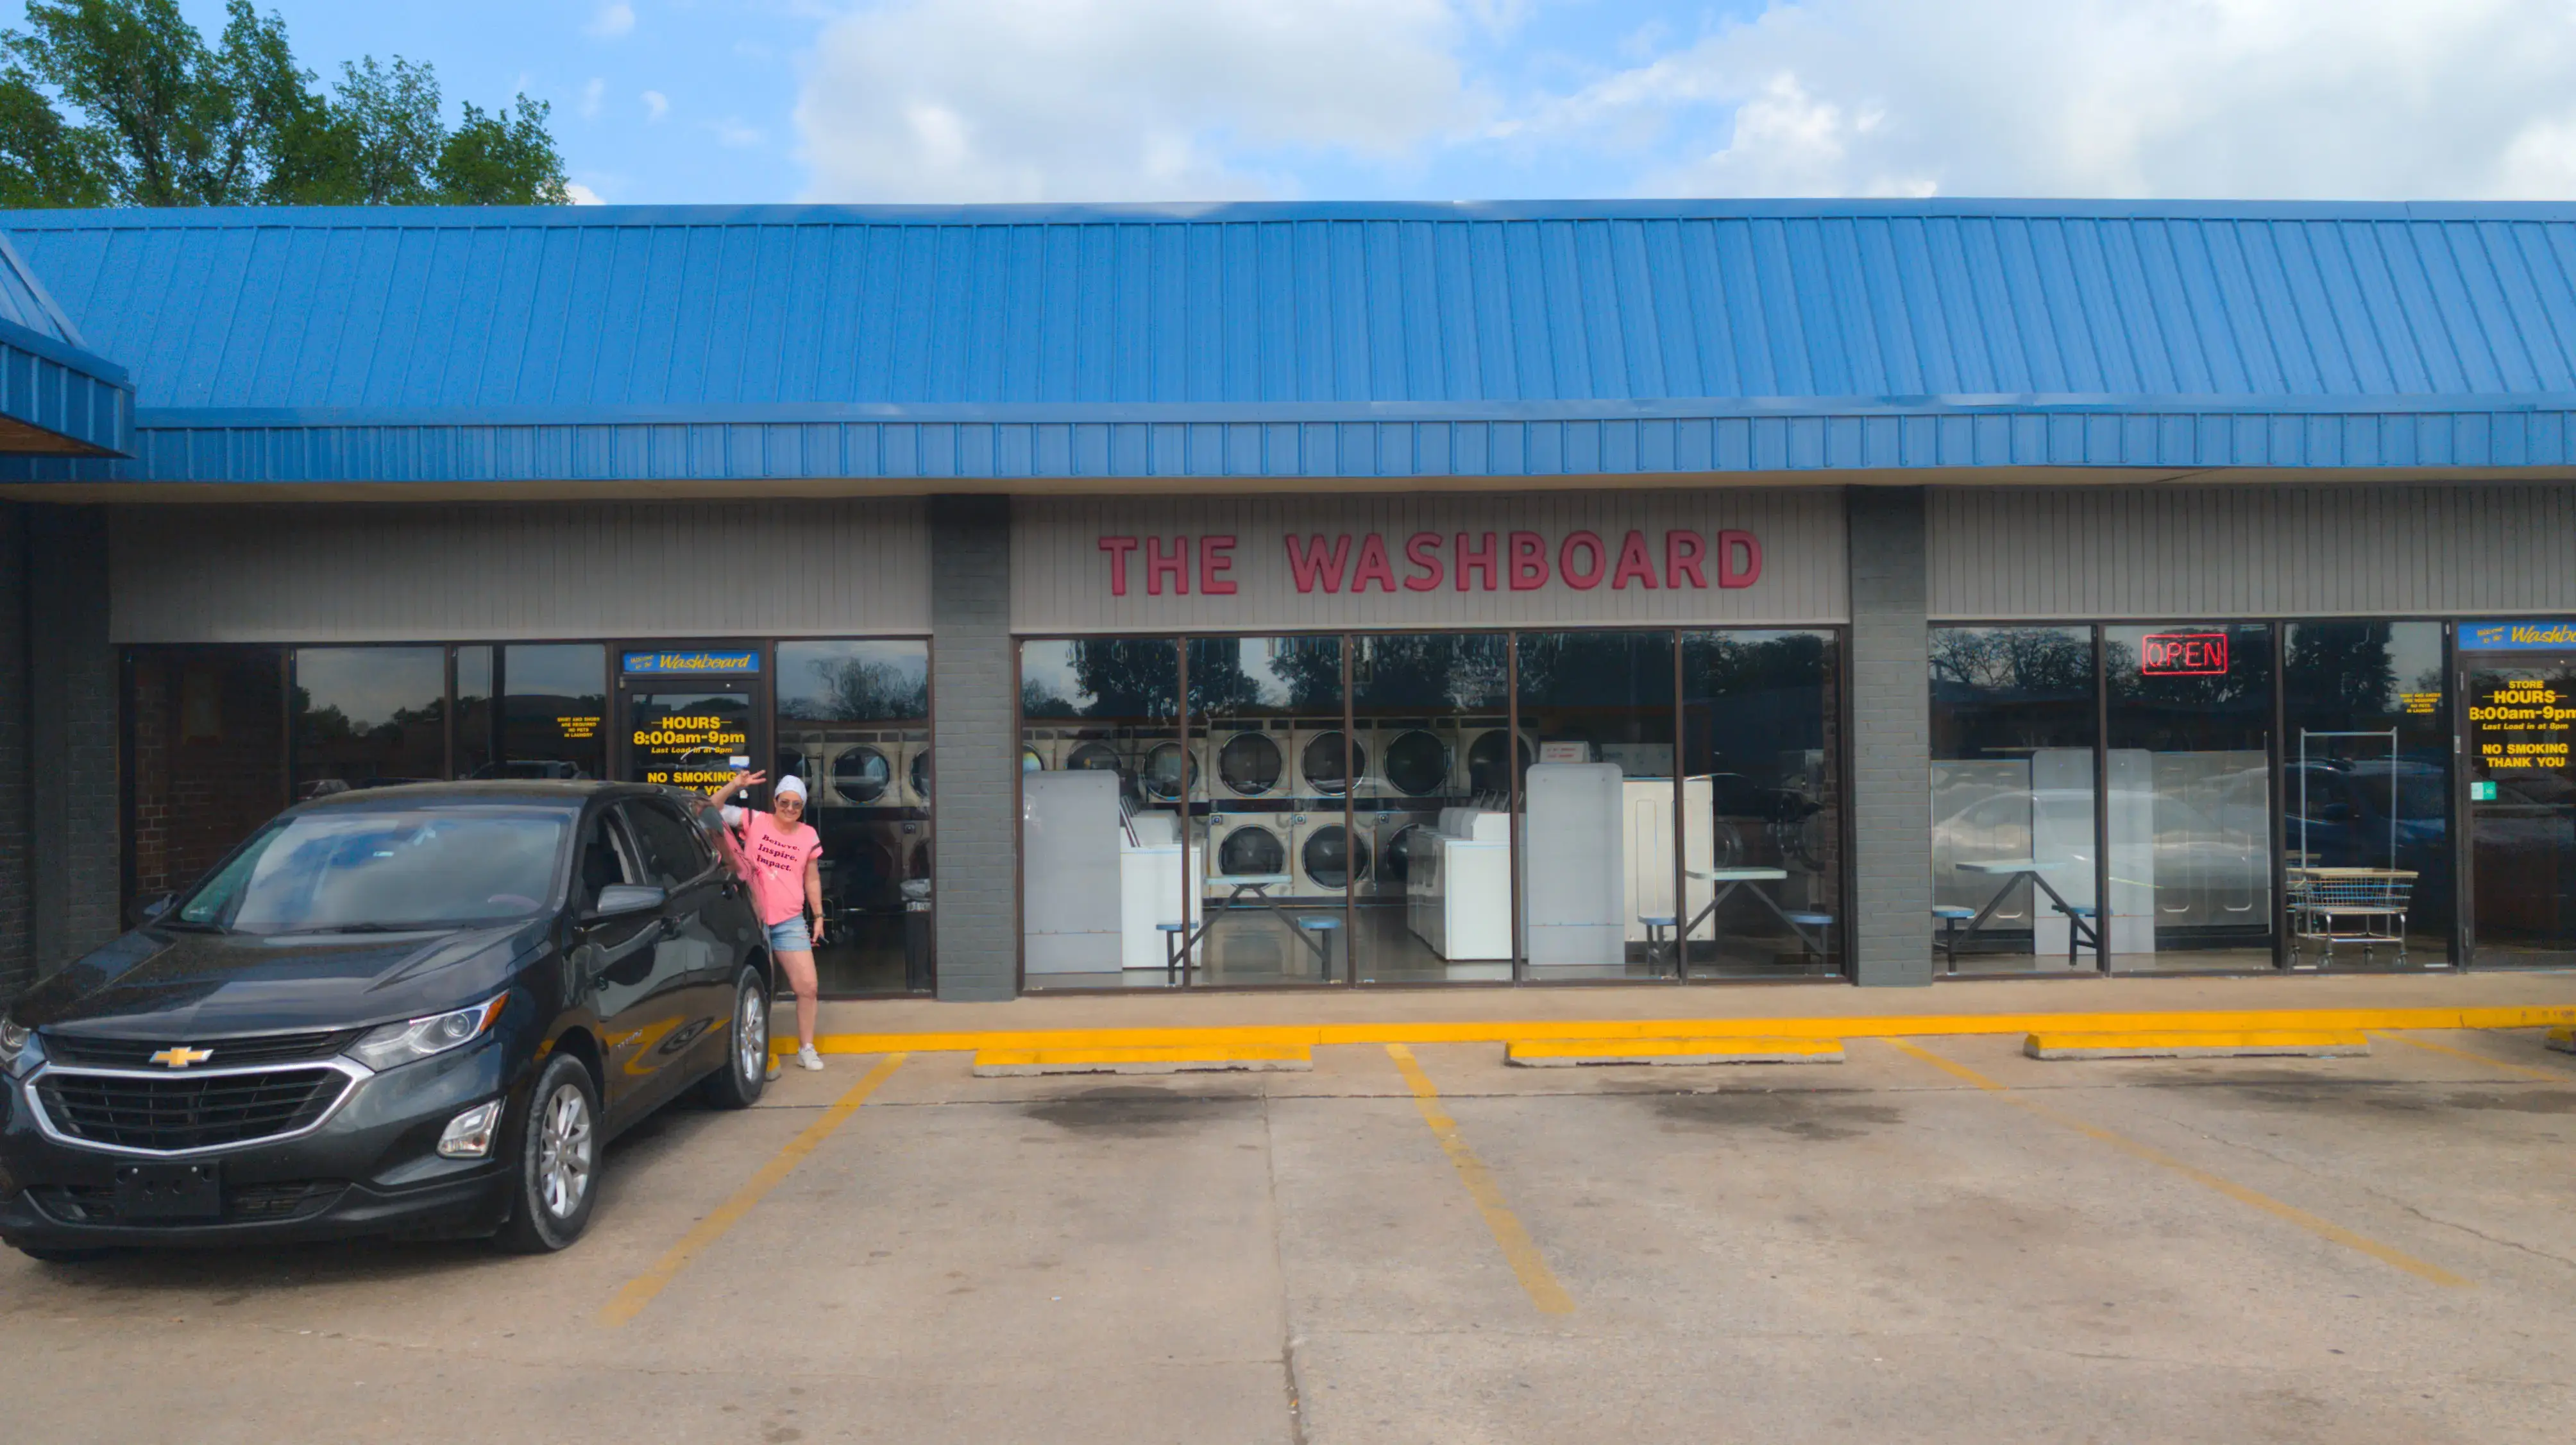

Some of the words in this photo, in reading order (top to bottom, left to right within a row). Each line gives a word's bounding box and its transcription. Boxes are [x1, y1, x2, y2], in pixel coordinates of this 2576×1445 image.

[1098, 535, 1237, 595] THE
[1284, 529, 1763, 594] WASHBOARD
[659, 653, 751, 669] Washboard
[2148, 642, 2221, 667] OPEN
[2509, 680, 2545, 689] STORE
[2493, 690, 2556, 704] HOURS
[662, 717, 721, 730] HOURS
[2549, 722, 2570, 731] 8pm
[633, 731, 745, 745] 8:00am-9pm
[2482, 744, 2502, 755] NO
[2507, 744, 2569, 755] SMOKING
[2486, 757, 2532, 767] THANK
[2536, 757, 2566, 767] YOU
[647, 772, 668, 783] NO
[674, 771, 738, 782] SMOKING
[704, 785, 724, 796] YO
[761, 834, 801, 851] Believe.
[758, 843, 798, 862] Inspire.
[756, 854, 792, 871] Impact.
